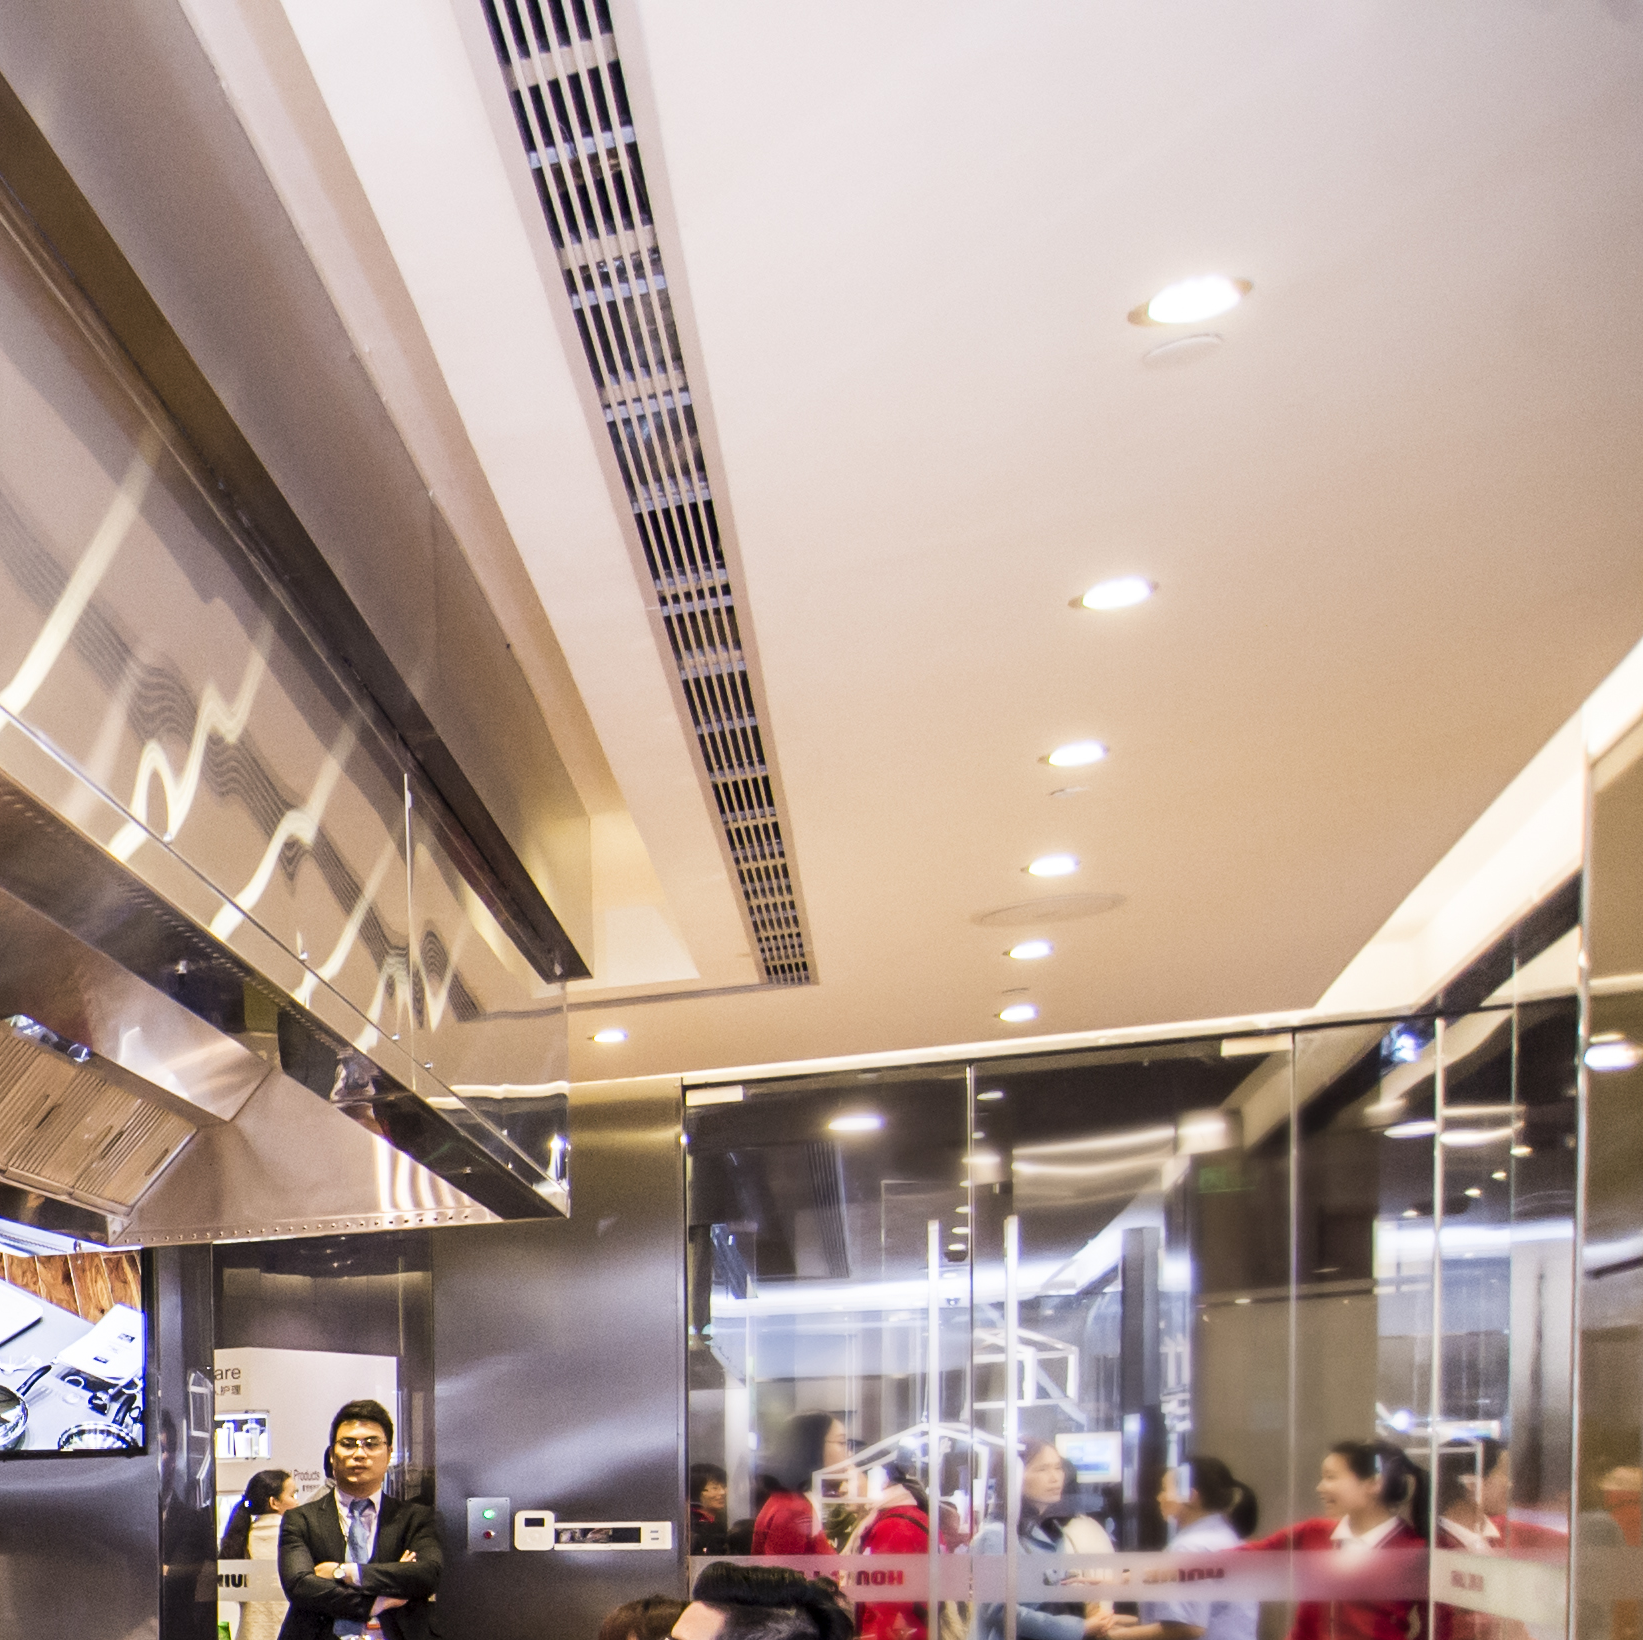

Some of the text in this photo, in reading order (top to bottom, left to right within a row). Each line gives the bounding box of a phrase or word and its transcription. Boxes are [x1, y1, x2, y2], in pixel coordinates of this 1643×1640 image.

[214, 1367, 241, 1380] are
[215, 1384, 241, 1396] 护理
[293, 1468, 321, 1481] Products
